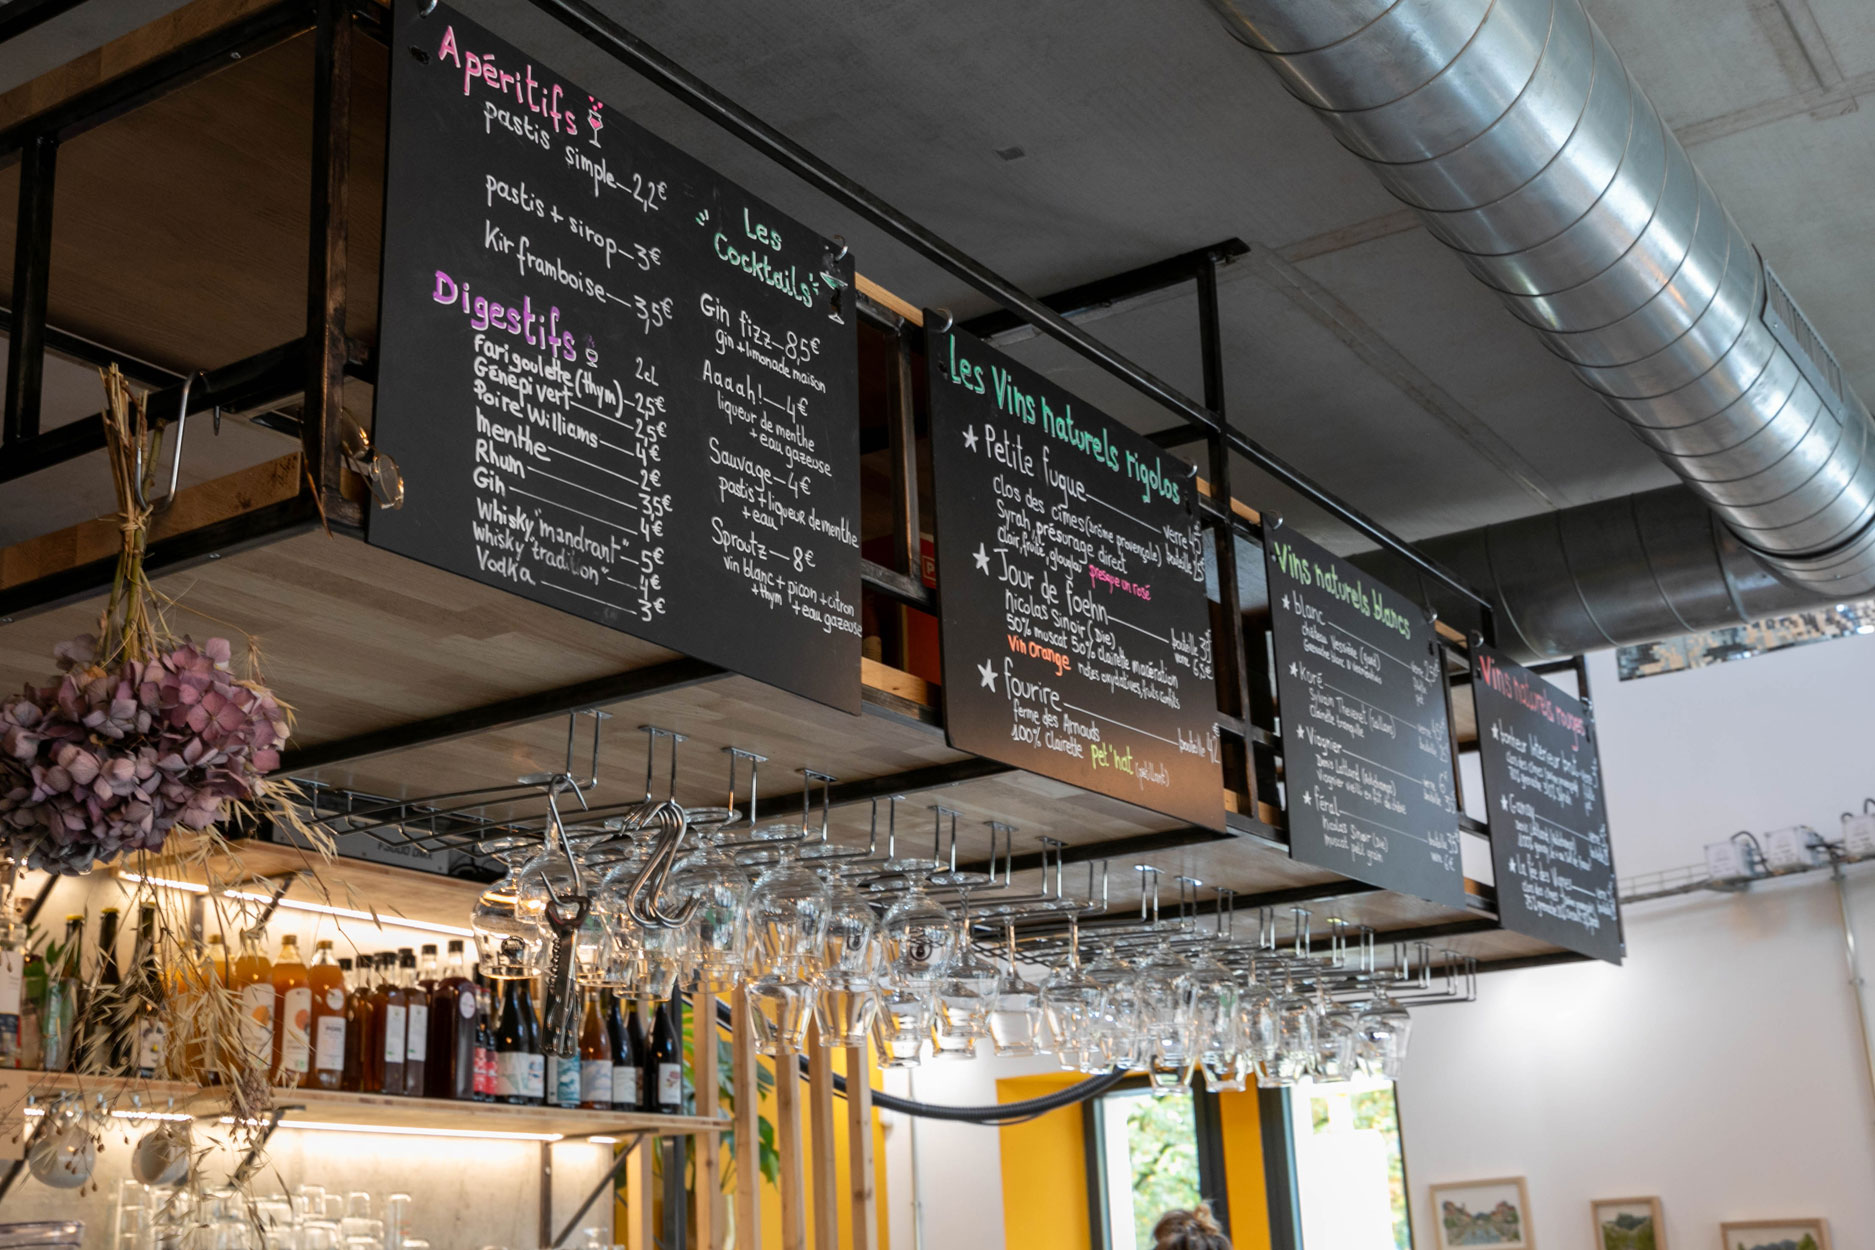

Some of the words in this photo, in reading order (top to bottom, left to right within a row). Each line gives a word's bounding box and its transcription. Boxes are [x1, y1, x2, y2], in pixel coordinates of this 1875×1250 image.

[438, 25, 577, 135] Apéritifs
[484, 101, 550, 150] pastis
[565, 146, 617, 197] simple
[486, 174, 545, 218] pastis
[569, 216, 617, 269] sirop
[633, 243, 661, 271] 3€
[744, 207, 782, 252] Les
[485, 219, 514, 253] Kir
[516, 236, 607, 303] framboise
[633, 294, 673, 334] 3,5€
[713, 232, 813, 308] Cocktails
[433, 271, 577, 362] Digestifs
[700, 293, 730, 328] Gin
[739, 311, 773, 350] fizz
[715, 329, 734, 355] gin
[793, 368, 826, 394] maison
[537, 385, 573, 411] vert
[634, 418, 667, 447] 2,5€
[575, 368, 624, 419] (thym)
[634, 393, 667, 421] 2,5€
[717, 390, 757, 424] liqueur
[760, 411, 774, 433] de
[776, 425, 815, 452] menthe
[787, 395, 810, 424] 4€
[949, 333, 986, 395] Les
[991, 365, 1036, 425] Vins
[1041, 395, 1119, 472] naturels
[1125, 450, 1181, 505] rigolos
[473, 379, 523, 419] Poire
[527, 403, 599, 448] Williams
[636, 442, 661, 467] 4€
[709, 437, 773, 492] Sauvage
[787, 472, 811, 499] 4€
[785, 445, 832, 477] gazeuse
[984, 424, 1035, 477] Petite
[473, 466, 506, 497] Gin
[640, 517, 663, 542] 4€
[476, 438, 525, 479] Rhum
[638, 493, 673, 521] 3,5€
[640, 469, 662, 492] 2€
[718, 476, 755, 503] pastis
[1025, 488, 1045, 514] des
[476, 497, 534, 542] Whisky
[641, 547, 664, 573] 5€
[792, 546, 816, 572] 8€
[1098, 544, 1128, 574] direct
[476, 544, 536, 587] Vodka
[637, 597, 666, 622] 3€
[640, 574, 661, 601] 4€
[743, 559, 775, 586] blanc
[787, 581, 818, 603] picon
[993, 548, 1034, 591] Jour
[1041, 570, 1059, 605] de
[1088, 564, 1120, 595] presque
[1121, 579, 1132, 594] un
[1132, 584, 1152, 601] rosé
[1274, 541, 1311, 585] Vins
[1314, 564, 1370, 617] naturels
[1371, 588, 1411, 640] blancs
[823, 613, 863, 637] gazeuse
[1006, 613, 1032, 637] 50%
[1033, 626, 1068, 649] muscat
[1071, 635, 1096, 659] 50%
[1007, 634, 1027, 655] Vin
[1078, 661, 1100, 681] notes
[1479, 655, 1512, 699] Vins
[1011, 724, 1042, 748] 100%
[1042, 707, 1059, 728] des
